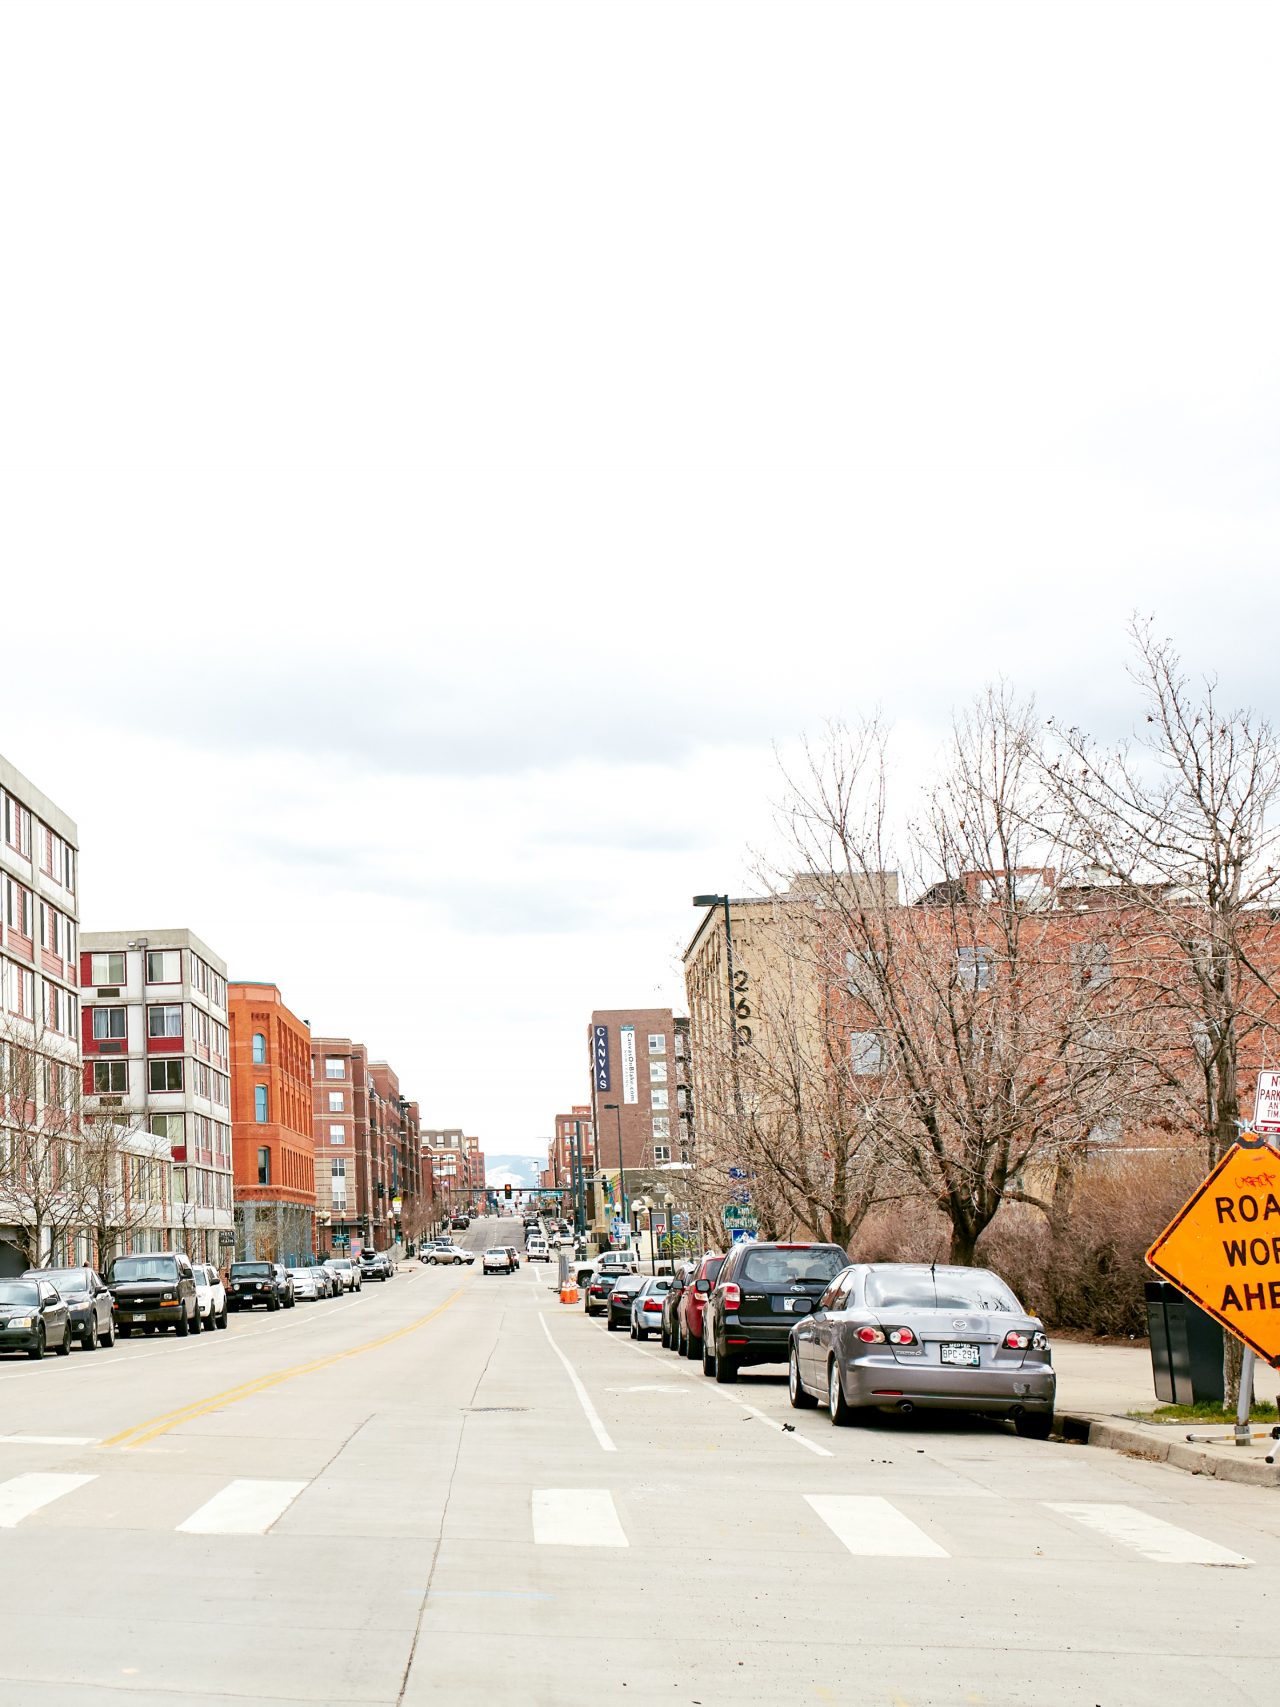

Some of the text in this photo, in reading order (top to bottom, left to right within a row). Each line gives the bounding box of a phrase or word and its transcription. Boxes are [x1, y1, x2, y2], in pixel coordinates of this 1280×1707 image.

[596, 1027, 607, 1089] CANVAS
[1271, 1075, 1280, 1087] N
[1268, 1101, 1280, 1110] AN
[1267, 1109, 1280, 1118] TIM
